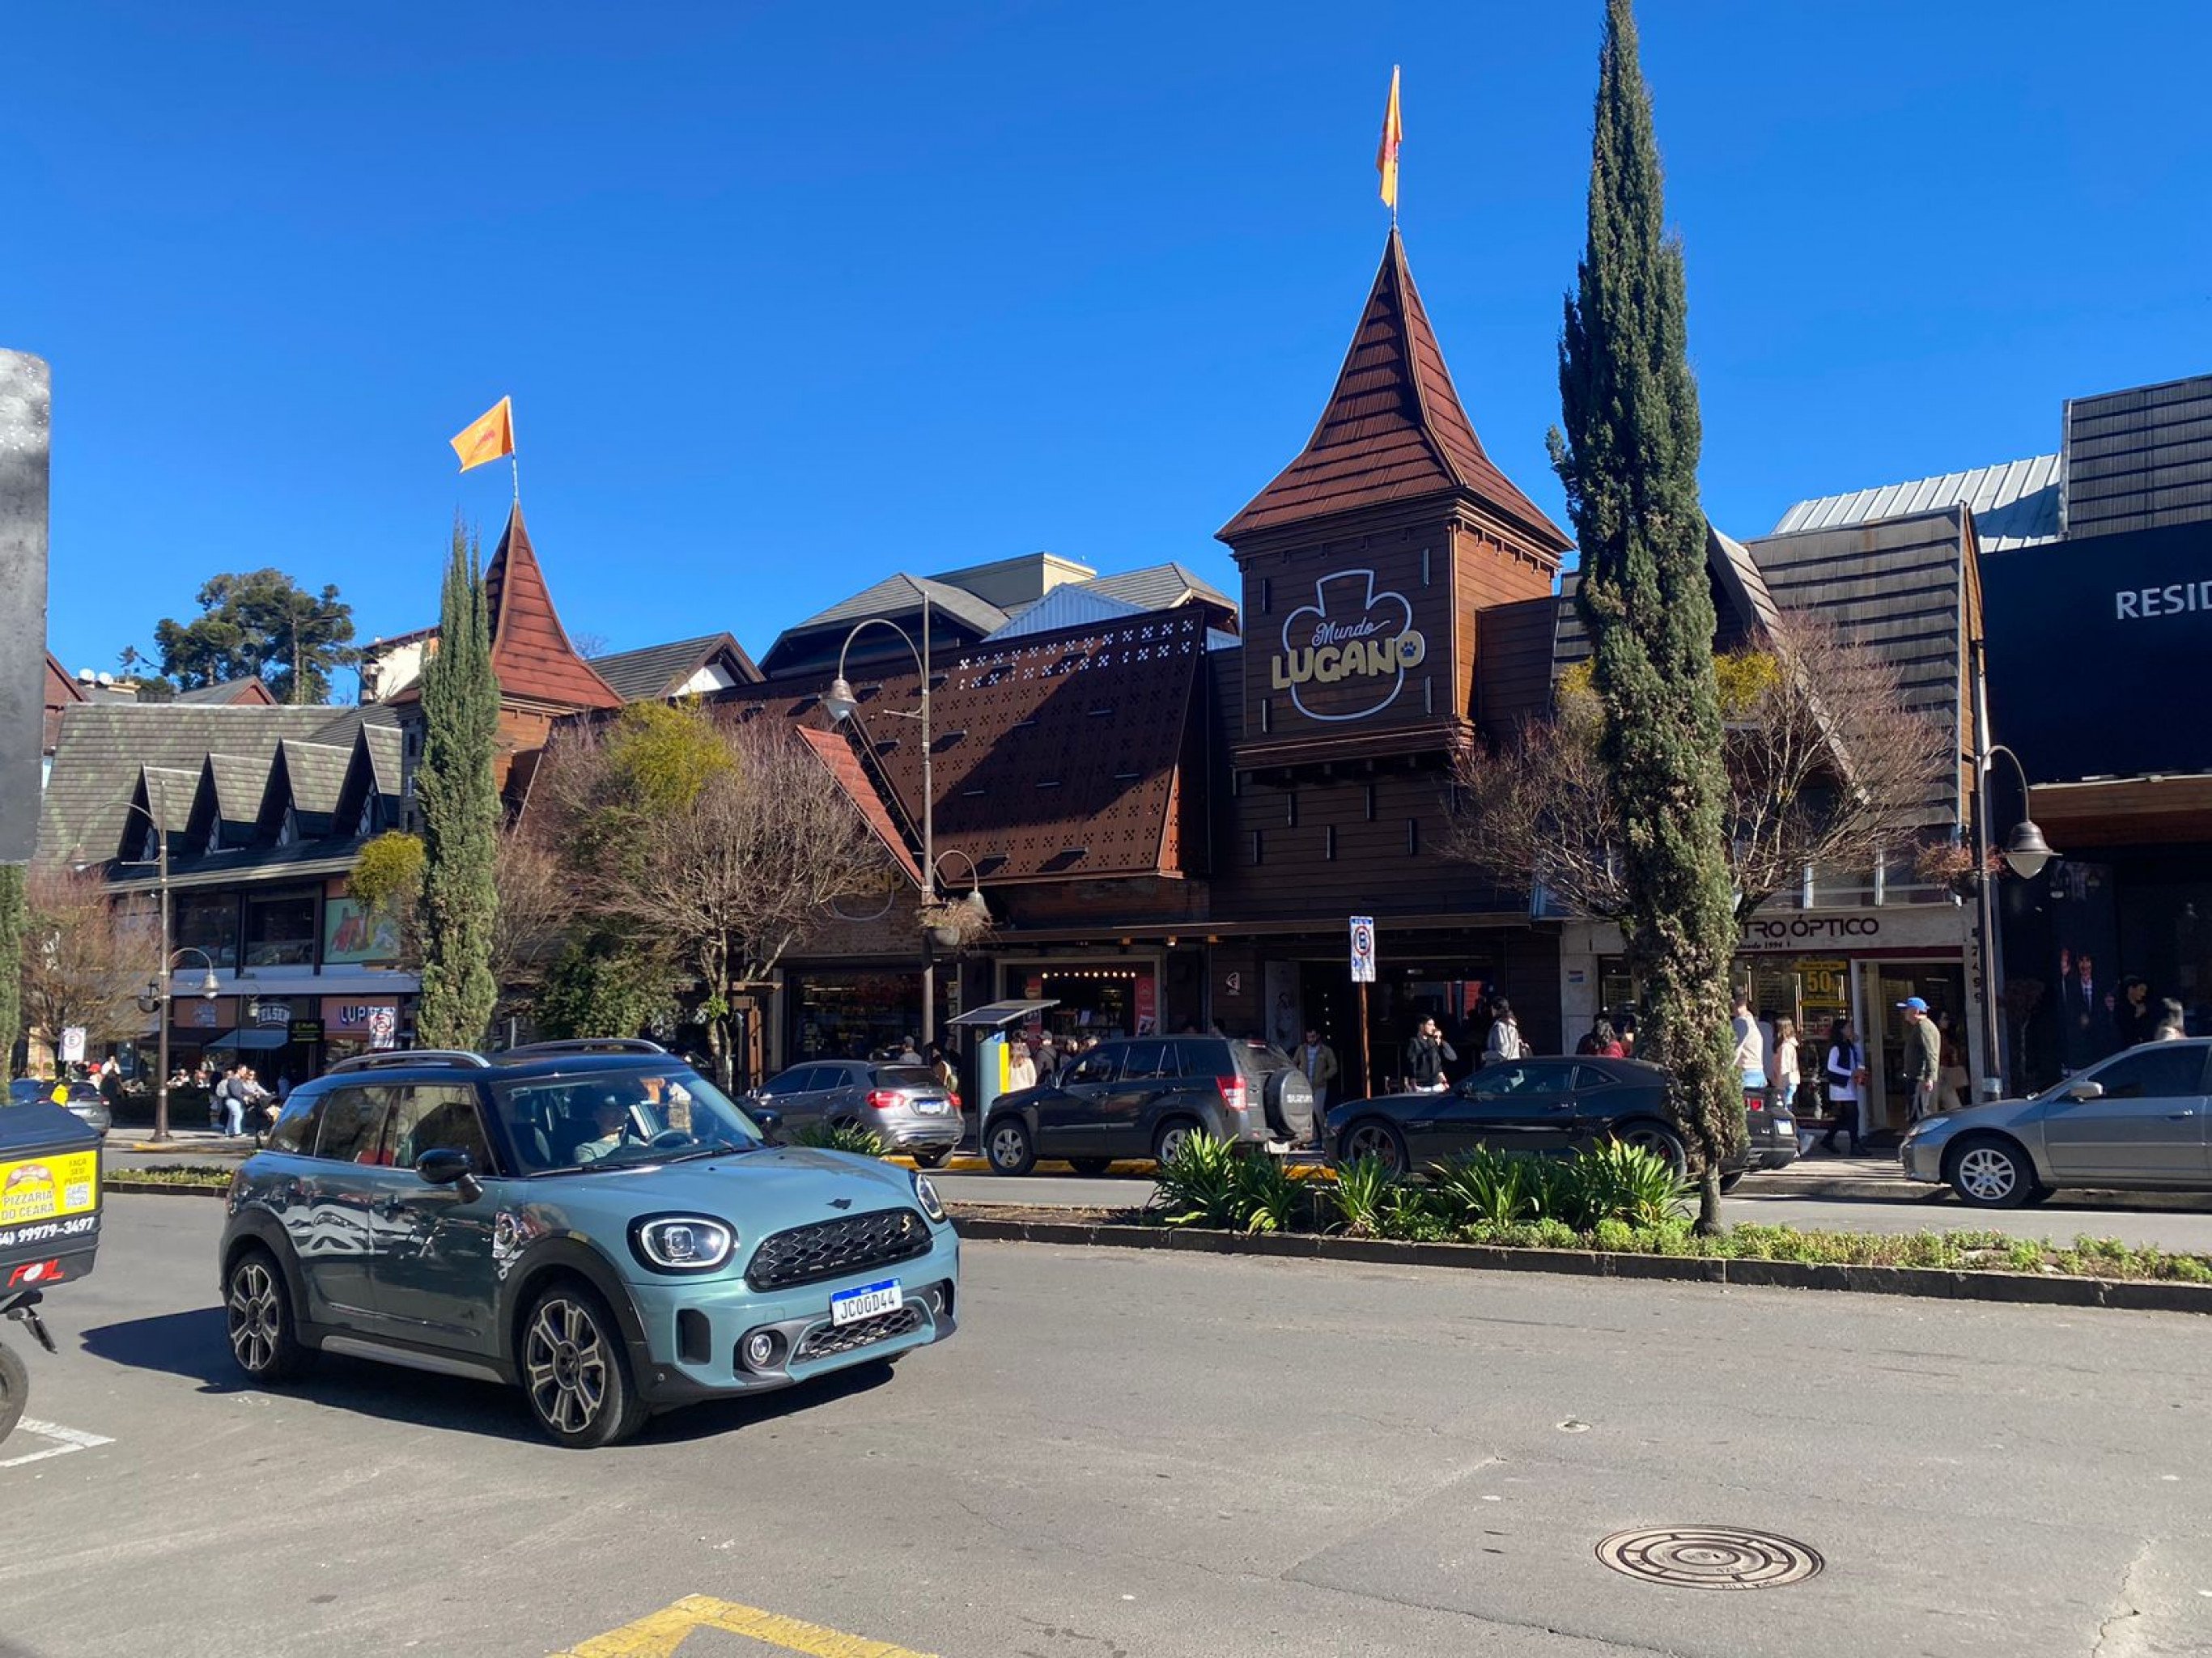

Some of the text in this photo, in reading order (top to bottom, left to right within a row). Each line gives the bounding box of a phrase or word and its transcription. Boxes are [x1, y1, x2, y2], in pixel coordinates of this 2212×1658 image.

[1312, 617, 1390, 647] Mundo
[1272, 630, 1425, 689] LUGANO
[1790, 914, 1879, 937] ÓPTICO
[341, 1005, 370, 1023] LUP
[3, 1190, 53, 1206] PIZZARIA
[1, 1208, 16, 1220] DO
